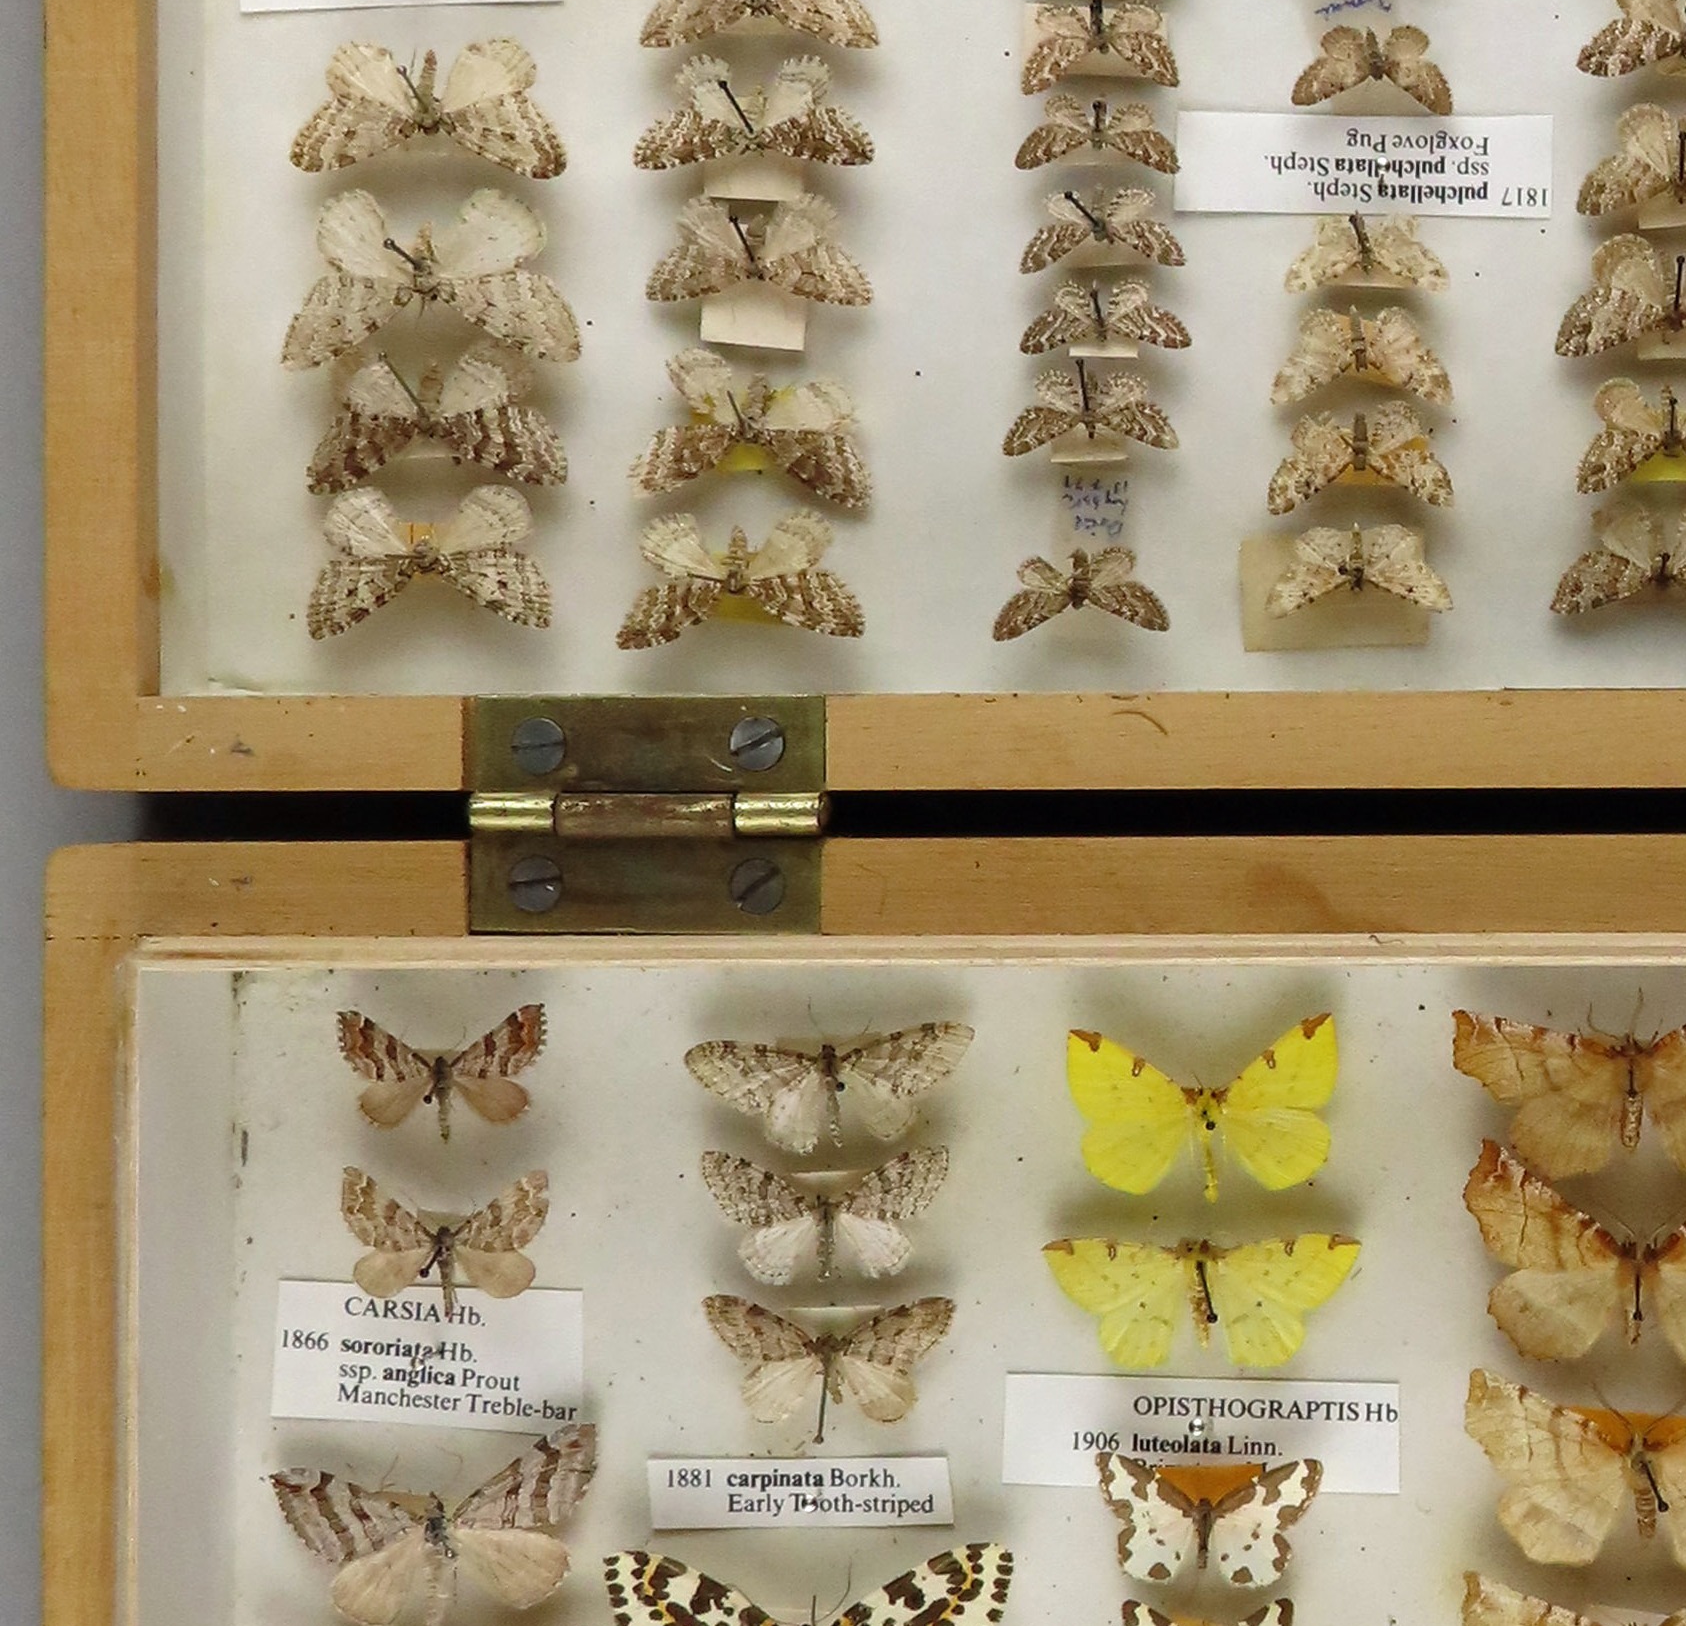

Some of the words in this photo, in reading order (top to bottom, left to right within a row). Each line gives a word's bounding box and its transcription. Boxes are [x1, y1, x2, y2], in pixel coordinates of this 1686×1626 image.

[1347, 128, 1386, 153] Pug
[1392, 127, 1488, 155] Foxglove
[1265, 152, 1329, 177] Steph.
[1308, 178, 1372, 203] Steph.
[1502, 188, 1546, 206] 1817
[283, 1330, 329, 1351] 1866
[461, 1368, 519, 1391] Prout
[338, 1381, 461, 1411] Manchester
[466, 1394, 579, 1426] Treble-bar
[1133, 1396, 1359, 1426] OPISTHOGRAPTIS
[1074, 1431, 1121, 1456] 1906
[1132, 1433, 1222, 1455] luteolata
[1228, 1436, 1282, 1456] Linn.
[668, 1468, 711, 1487] 1881
[727, 1469, 824, 1492] carpinata
[830, 1468, 900, 1488] Borkh.
[728, 1494, 784, 1517] Early
